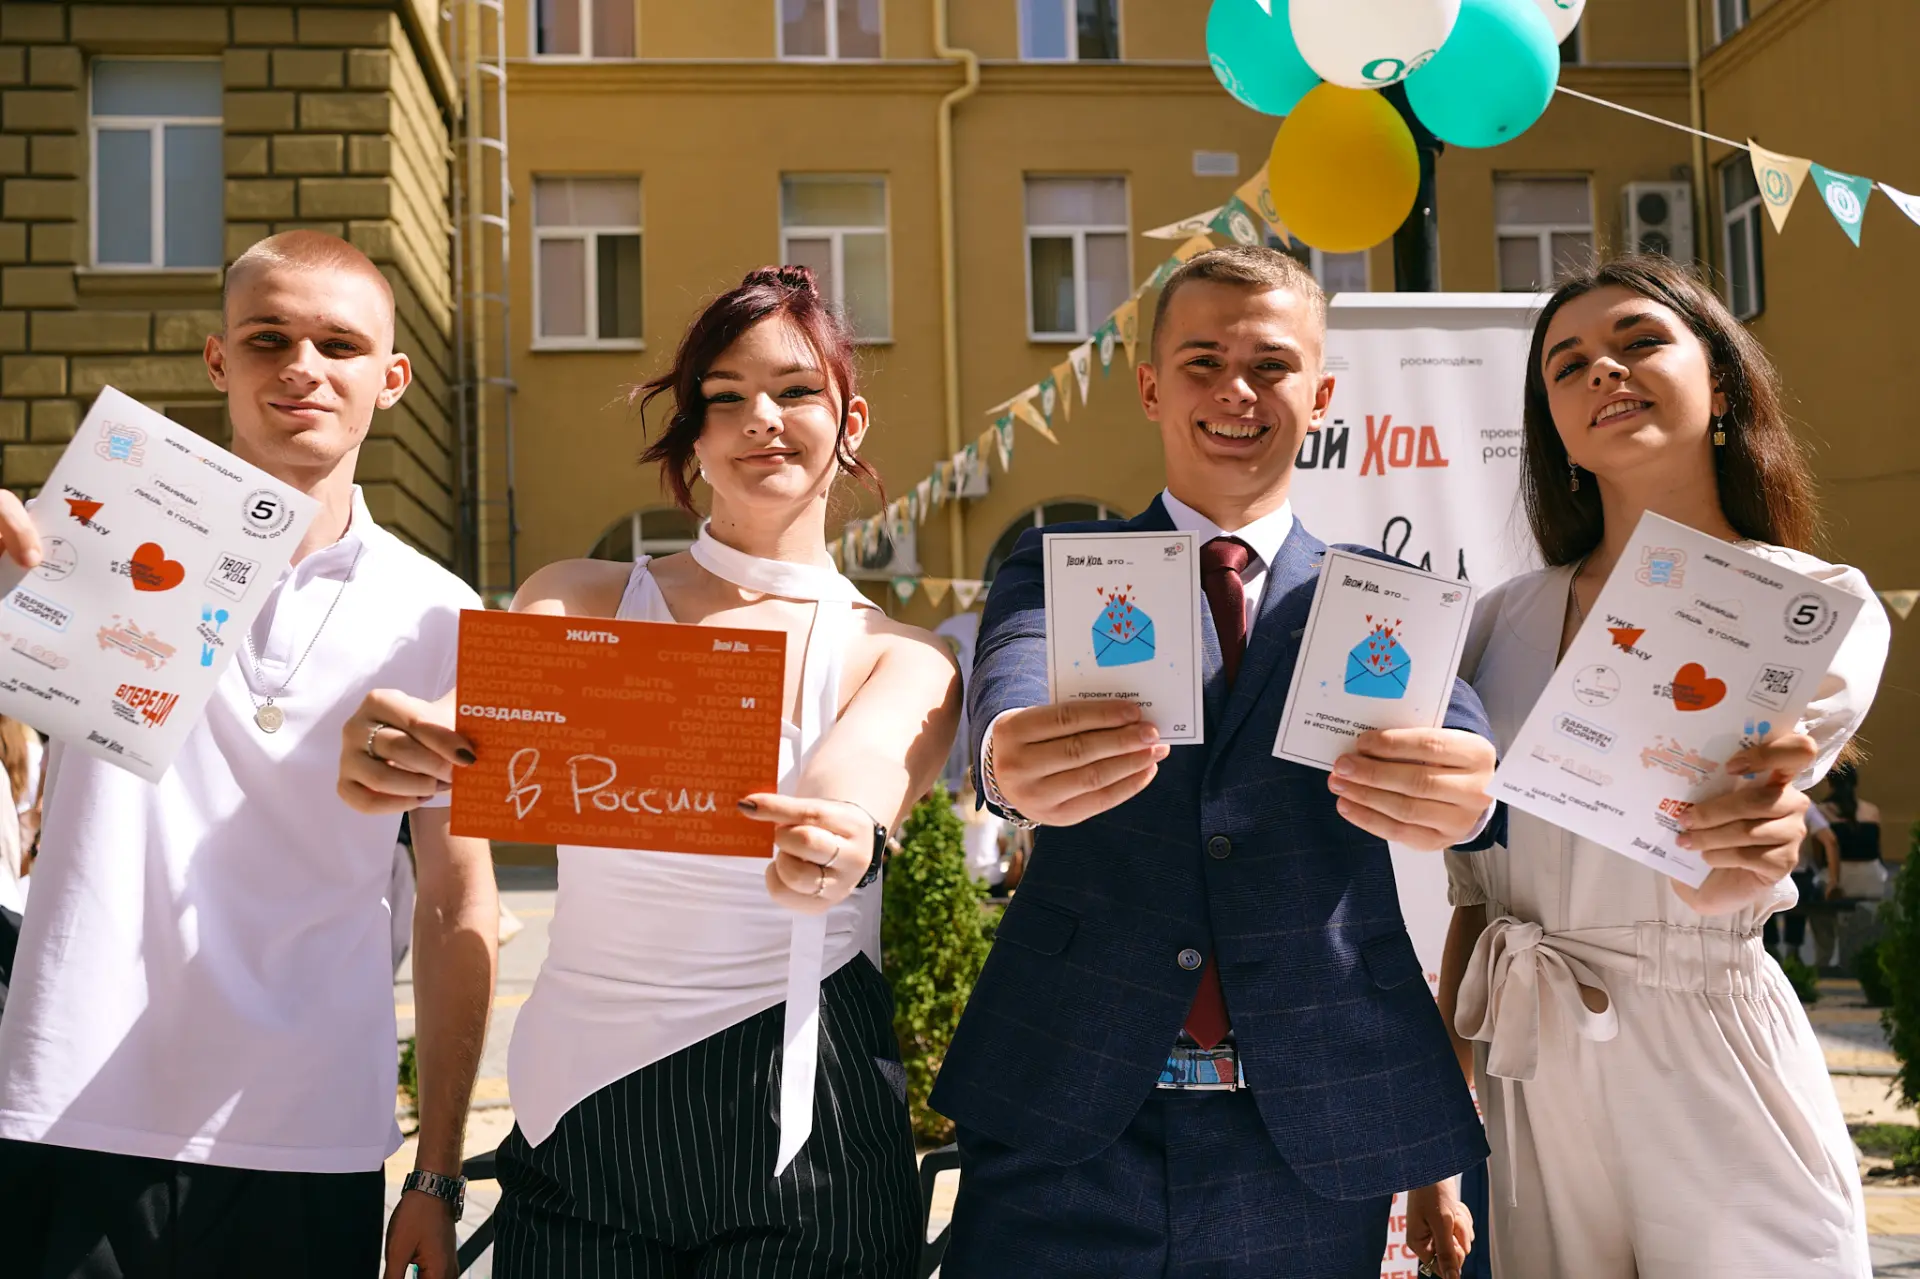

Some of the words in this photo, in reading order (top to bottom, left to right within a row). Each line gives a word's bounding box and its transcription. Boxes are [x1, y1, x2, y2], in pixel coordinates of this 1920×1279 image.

[1480, 428, 1526, 442] проек
[1482, 446, 1527, 464] рос
[203, 458, 244, 483] СОЗДАЮ
[154, 479, 198, 506] ГРАНИЦЫ
[251, 500, 277, 520] 5
[174, 513, 209, 535] ГОЛОВЕ
[218, 556, 252, 576] ТВОЙ
[1742, 569, 1784, 590] СОЗДАЮ
[1384, 589, 1402, 599] это
[13, 597, 62, 627] ТВОРИТЬ
[15, 591, 67, 622] ЗАРЯЖЕН
[1793, 604, 1819, 625] 5
[565, 628, 619, 644] ЖИТЬ
[1078, 691, 1113, 699] проект
[1115, 691, 1140, 699] один
[114, 683, 180, 729] ВПЕРЕДИ
[459, 703, 566, 724] СОЗДАВАТЬ
[1173, 724, 1187, 732] 02
[1315, 712, 1351, 725] проект
[1312, 722, 1355, 737] историй
[1560, 723, 1606, 748] ТВОРИТЬ
[1561, 717, 1612, 743] ЗАРЯЖЕН
[566, 754, 717, 814] России
[1502, 782, 1523, 793] ШАГ
[1524, 791, 1536, 800] ЗА
[1531, 787, 1566, 805] ШАГОМ
[1658, 797, 1694, 819] ВПЕ
